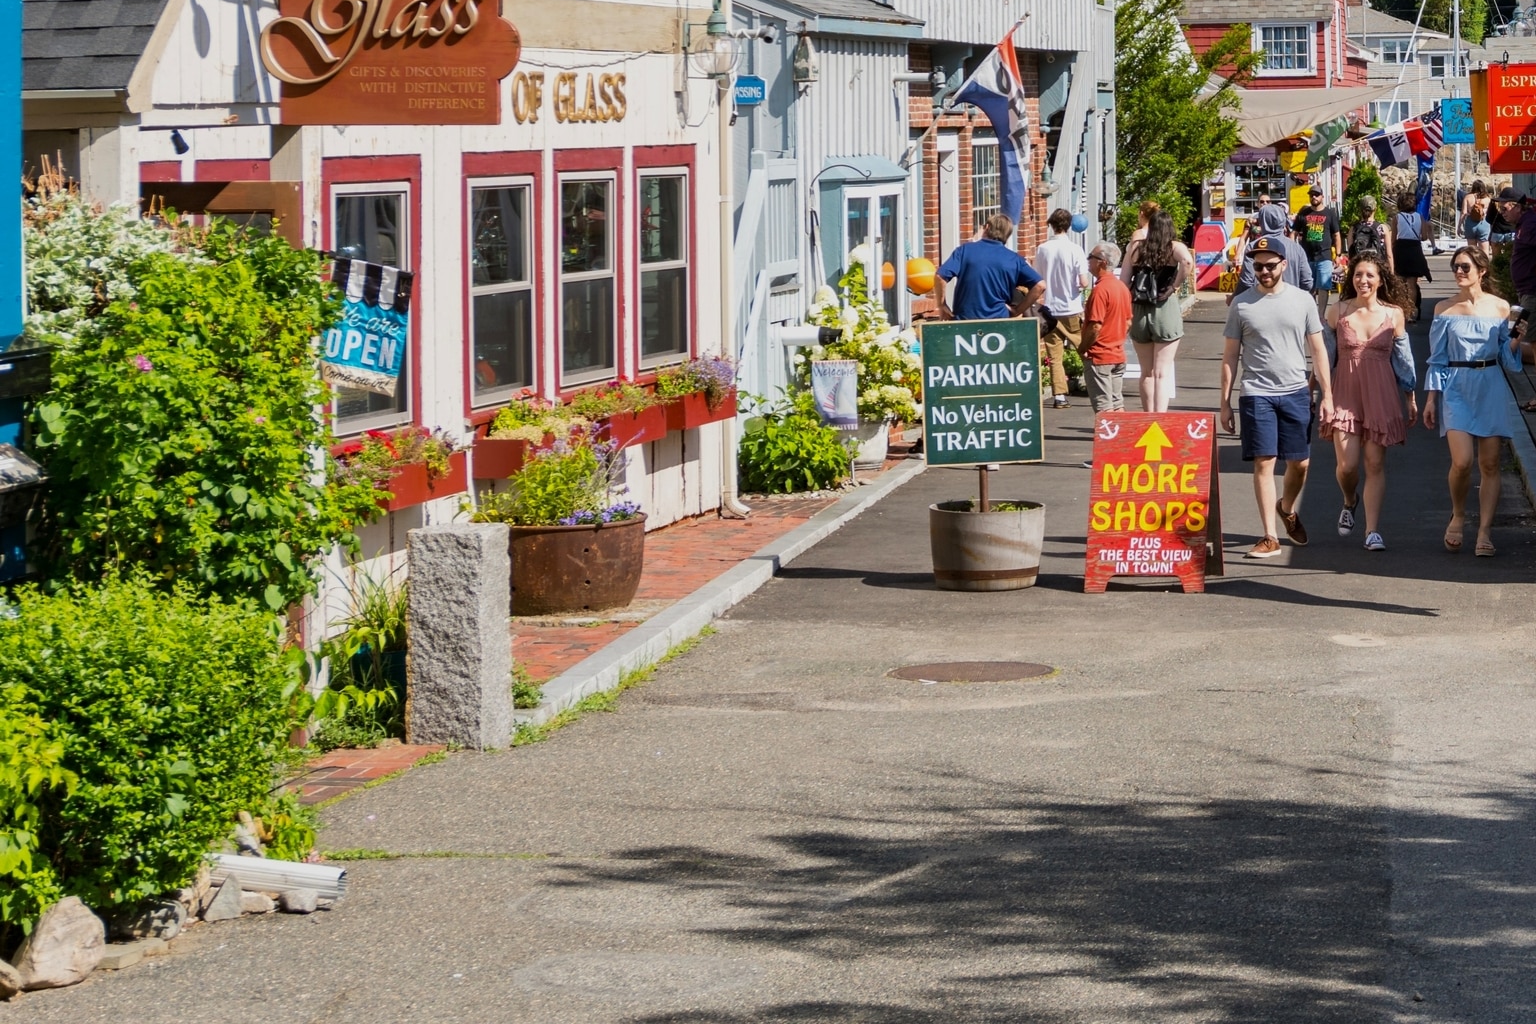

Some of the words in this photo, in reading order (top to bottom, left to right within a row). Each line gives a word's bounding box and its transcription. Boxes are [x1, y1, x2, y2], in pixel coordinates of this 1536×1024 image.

[350, 66, 386, 77] GIFTS
[390, 66, 400, 77] &
[405, 66, 486, 77] DISCOVERIES
[360, 81, 397, 94] WITH
[404, 81, 486, 94] DISTINCTIVE
[735, 86, 762, 98] ASSING
[408, 98, 486, 110] DIFFERENCE
[511, 70, 545, 124] OF
[552, 71, 627, 124] GLASS
[1495, 104, 1523, 118] ICE
[1257, 238, 1268, 249] G
[365, 317, 401, 337] are
[325, 328, 397, 369] OPEN
[954, 332, 1007, 357] NO
[813, 367, 856, 377] Welcome
[928, 361, 1033, 388] PARKING
[931, 406, 958, 425] No
[960, 402, 1032, 425] Vehicle
[931, 428, 1032, 452] TRAFFIC
[1102, 463, 1199, 493] MORE
[1091, 501, 1206, 532] SHOPS
[1130, 537, 1162, 549] PLUS
[1099, 549, 1123, 561] THE
[1126, 549, 1158, 561] BEST
[1161, 549, 1192, 561] VIEW
[1115, 561, 1129, 574] IN
[1132, 561, 1174, 574] TOWN!
